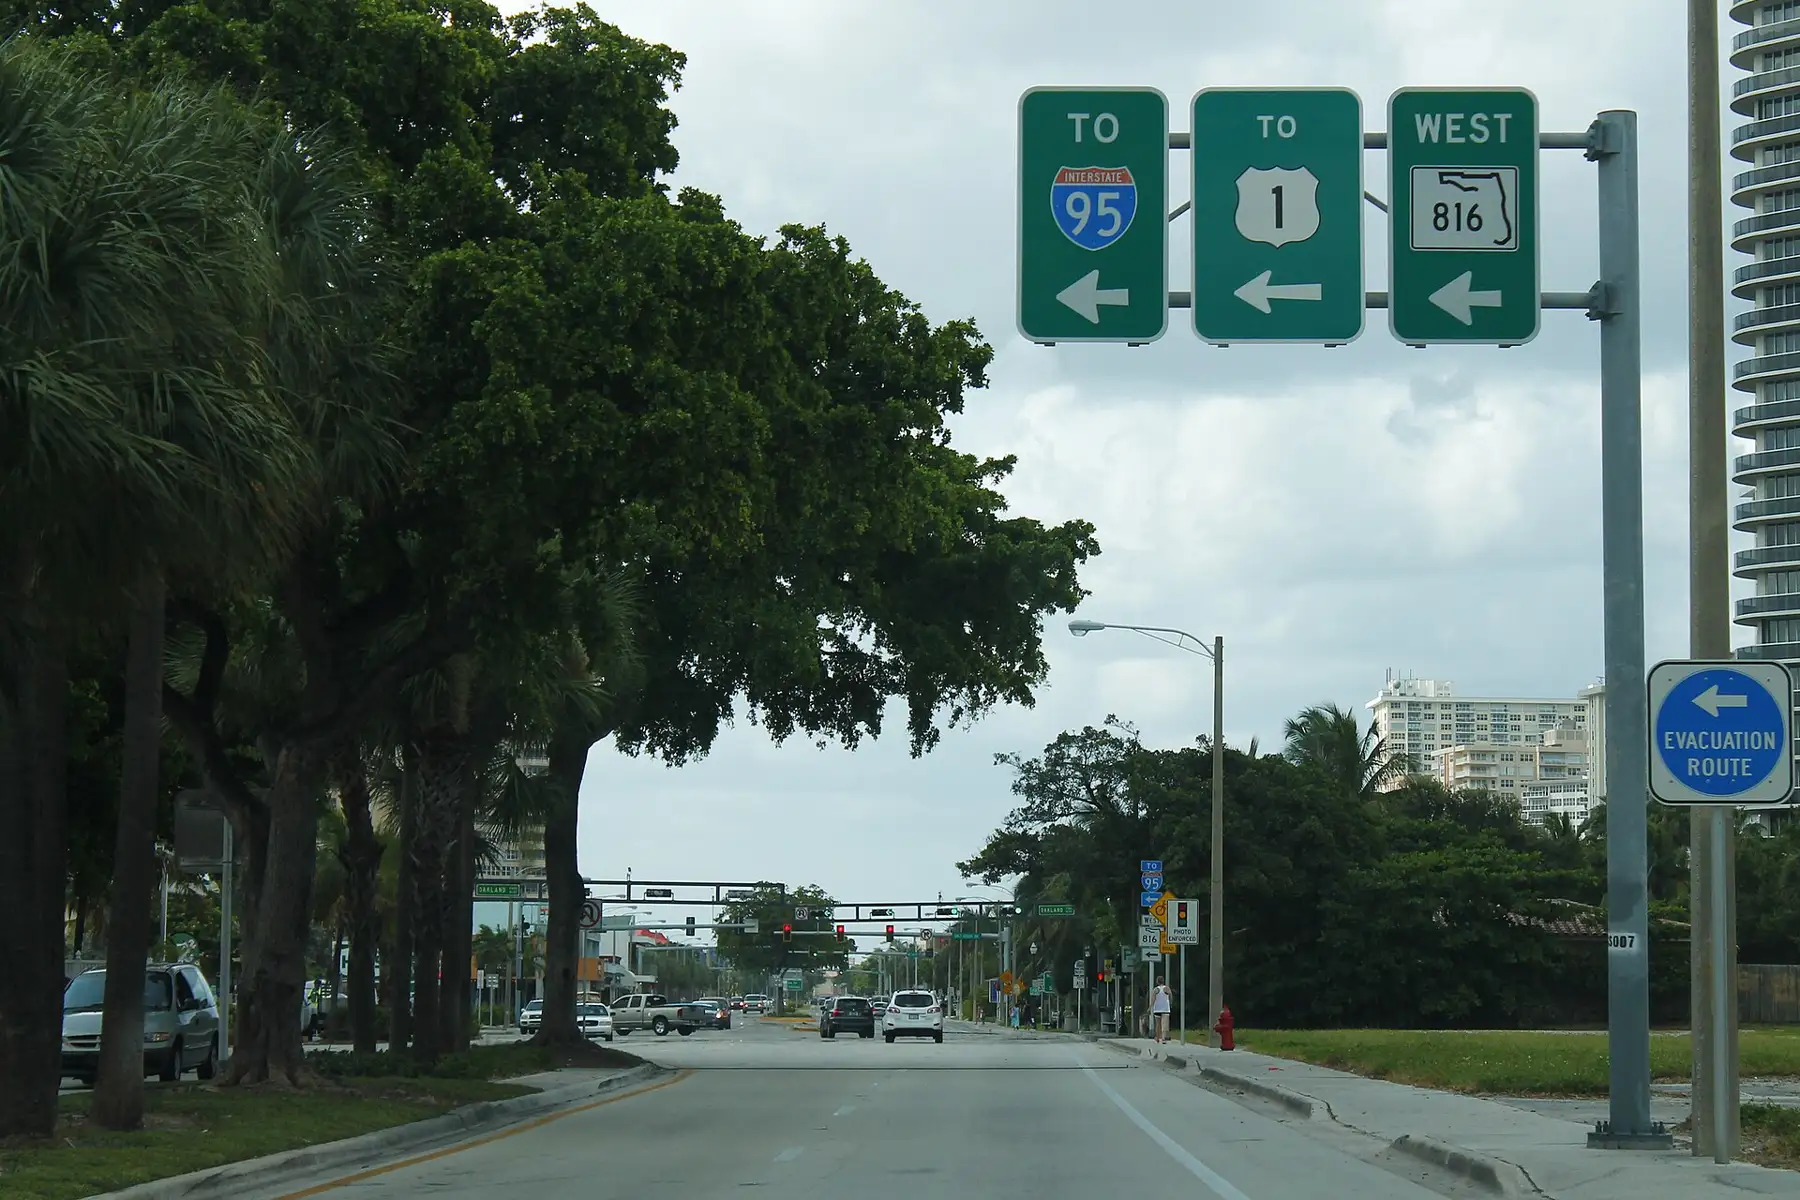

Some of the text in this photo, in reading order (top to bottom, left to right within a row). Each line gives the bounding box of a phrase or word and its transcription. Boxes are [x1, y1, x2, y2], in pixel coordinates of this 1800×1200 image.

[1067, 113, 1119, 144] TO
[1256, 115, 1296, 139] TO
[1414, 113, 1512, 144] WEST
[1064, 171, 1123, 184] INTERSTATE
[1066, 192, 1122, 237] 95
[1270, 185, 1284, 229] 1
[1432, 203, 1483, 231] 816
[1664, 731, 1776, 750] EVACUATION
[1687, 758, 1753, 777] ROUTE
[1145, 878, 1159, 889] 95
[1142, 935, 1157, 943] 816
